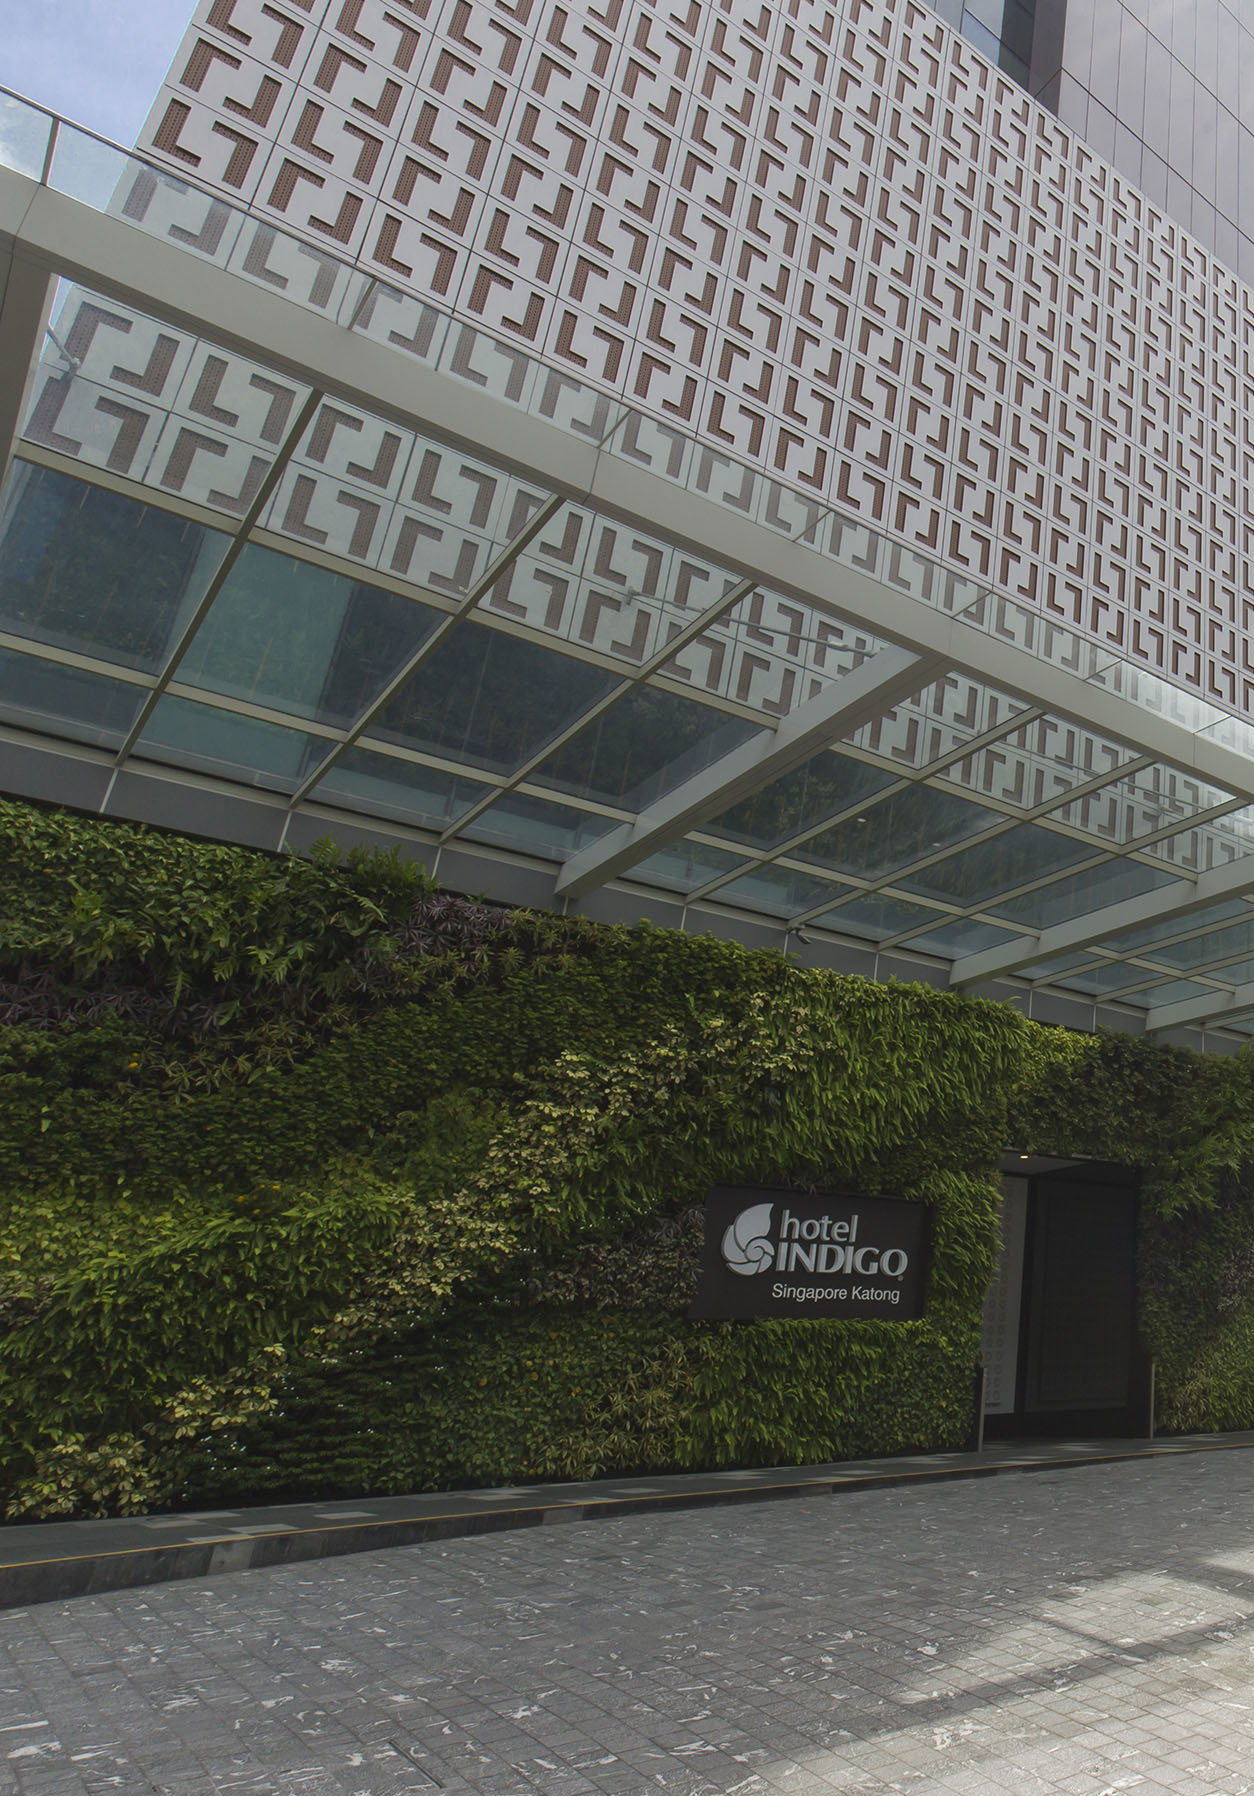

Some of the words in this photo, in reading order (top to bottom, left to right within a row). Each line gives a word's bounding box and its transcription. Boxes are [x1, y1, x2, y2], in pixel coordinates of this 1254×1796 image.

[779, 1209, 859, 1243] hotel
[775, 1242, 909, 1277] INDIGO
[771, 1283, 848, 1303] Singapore
[851, 1286, 901, 1305] Katong
